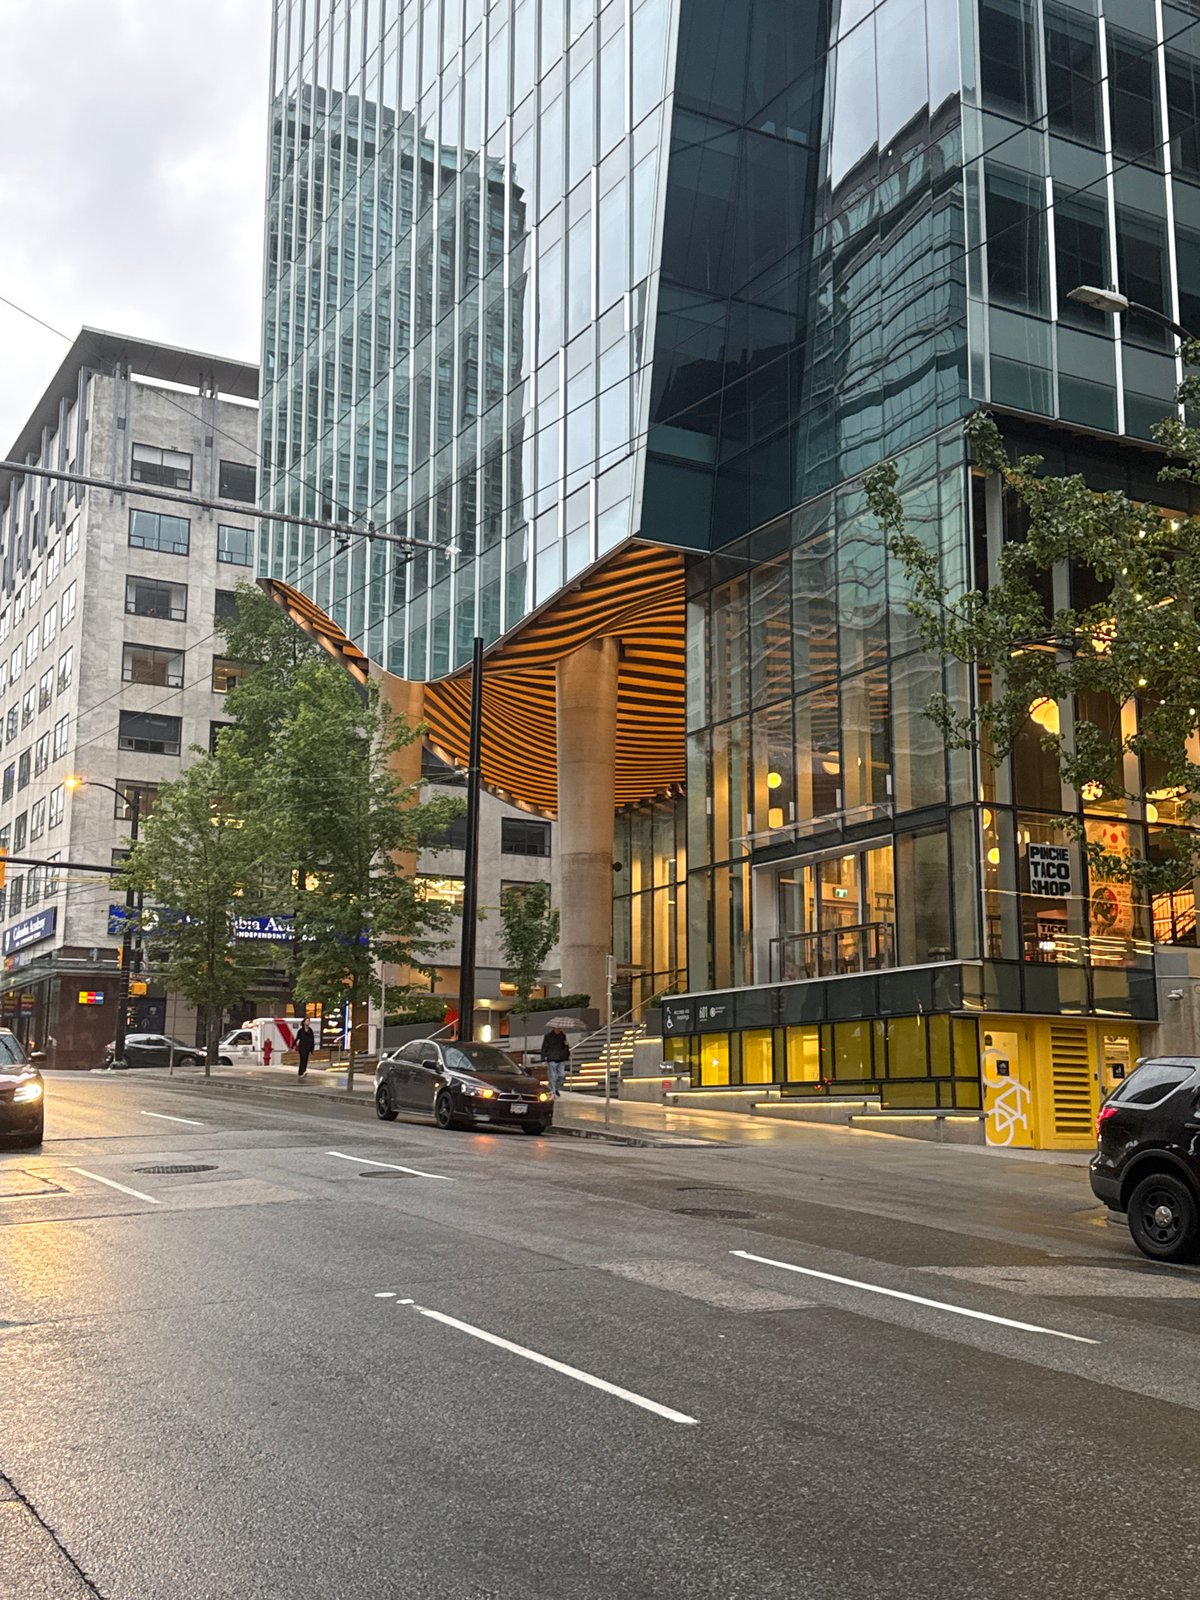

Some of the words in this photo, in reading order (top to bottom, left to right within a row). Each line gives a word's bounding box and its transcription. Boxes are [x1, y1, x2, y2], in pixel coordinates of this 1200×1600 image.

[1030, 846, 1069, 861] PINCHE
[1030, 862, 1070, 879] TACO
[1032, 880, 1071, 896] SHOP
[1040, 924, 1068, 934] TACO
